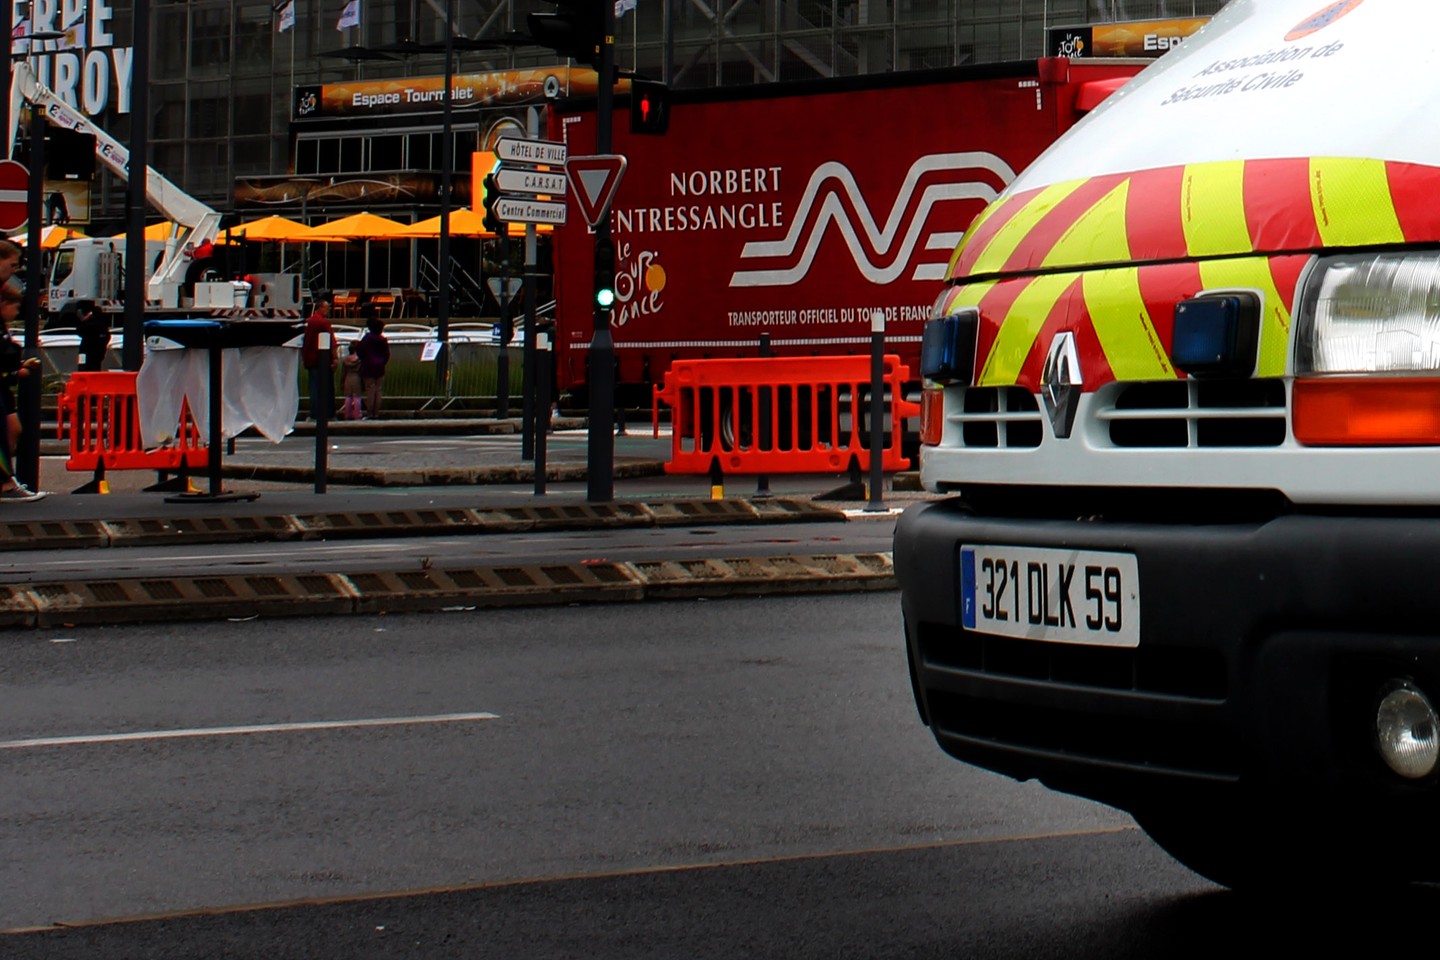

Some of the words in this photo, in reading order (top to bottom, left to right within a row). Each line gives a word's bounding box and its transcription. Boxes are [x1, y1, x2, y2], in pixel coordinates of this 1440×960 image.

[1143, 33, 1189, 51] Esp
[1193, 44, 1312, 78] Association
[1310, 39, 1345, 58] de
[1240, 68, 1304, 92] Civile
[353, 91, 400, 109] Espace
[510, 142, 532, 157] HÔTEL
[535, 146, 544, 159] DE
[547, 149, 565, 161] VILLE
[670, 166, 783, 197] NORBERT
[502, 203, 524, 216] Centre
[526, 205, 565, 219] Commercial
[587, 202, 784, 235] NTRESSANGLE
[727, 310, 797, 327] TRANSPORTEUR
[799, 308, 839, 325] OFFICIEL
[841, 307, 855, 323] DU
[885, 306, 898, 322] DE
[900, 304, 933, 322] FRANC
[981, 557, 1020, 623] 321
[1027, 561, 1077, 629] DLK
[1084, 565, 1122, 633] 59
